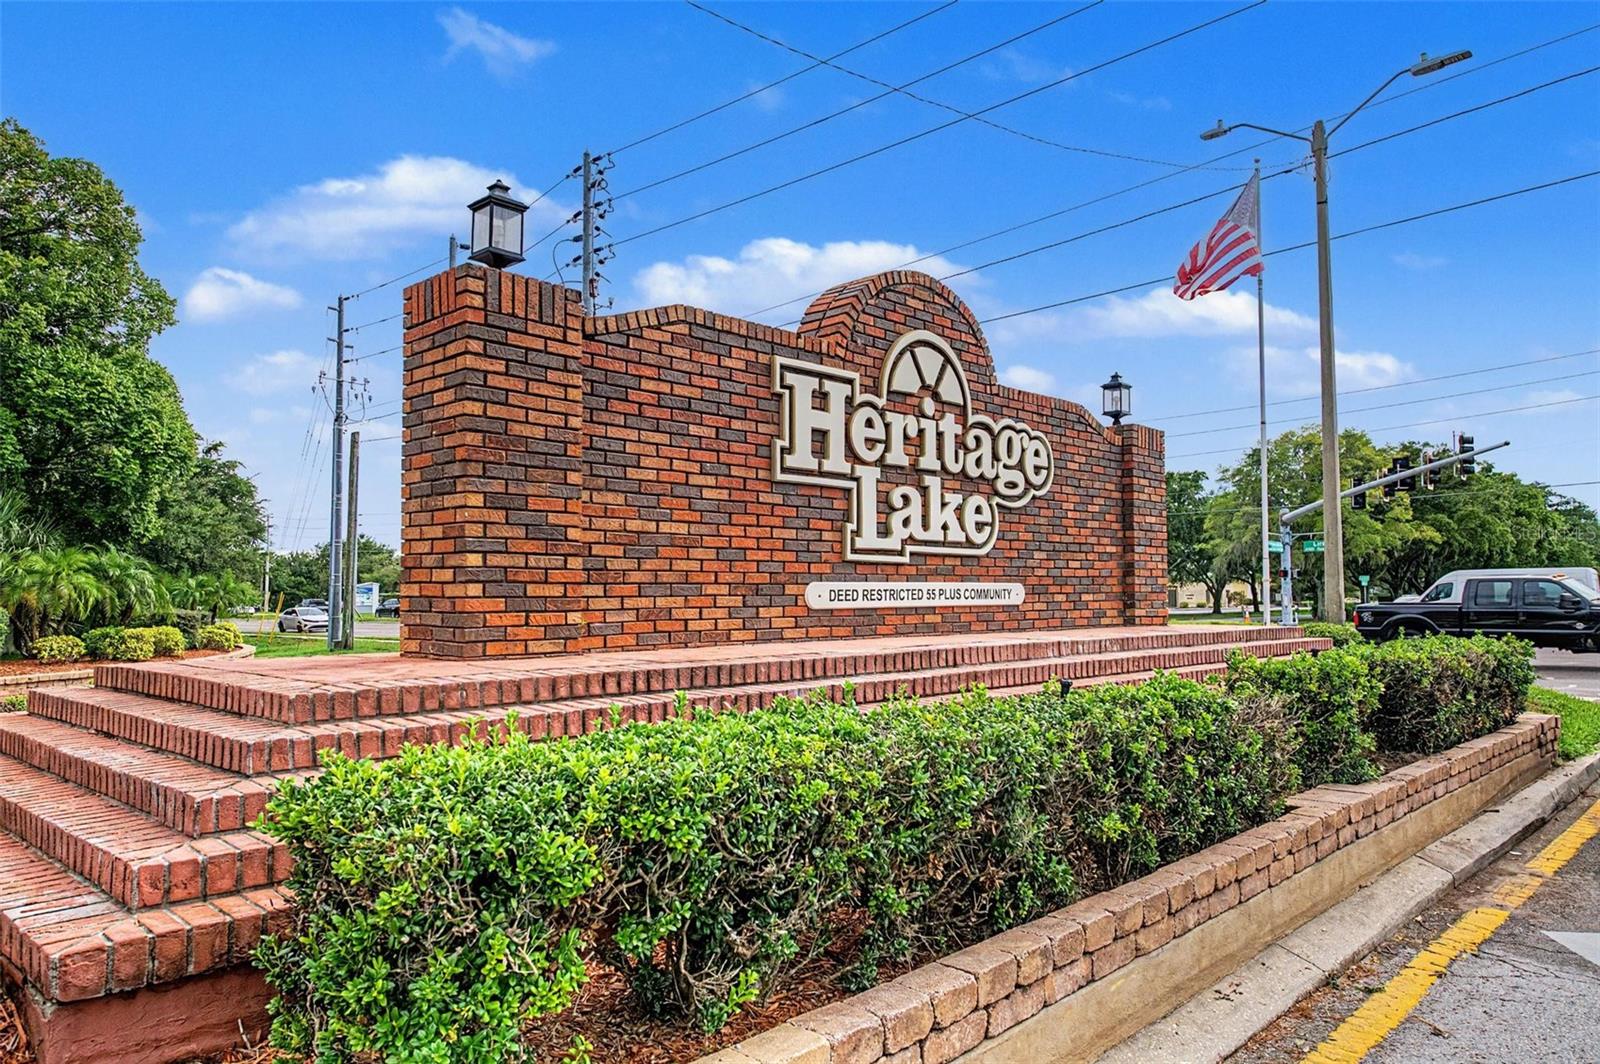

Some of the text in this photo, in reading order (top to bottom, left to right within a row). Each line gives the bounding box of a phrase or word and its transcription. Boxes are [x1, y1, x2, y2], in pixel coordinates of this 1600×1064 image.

[783, 371, 1050, 497] Heritage
[852, 464, 993, 551] Lake
[828, 587, 1012, 602] DEED RESTRICTED 55 PLUS COMMUNITY
